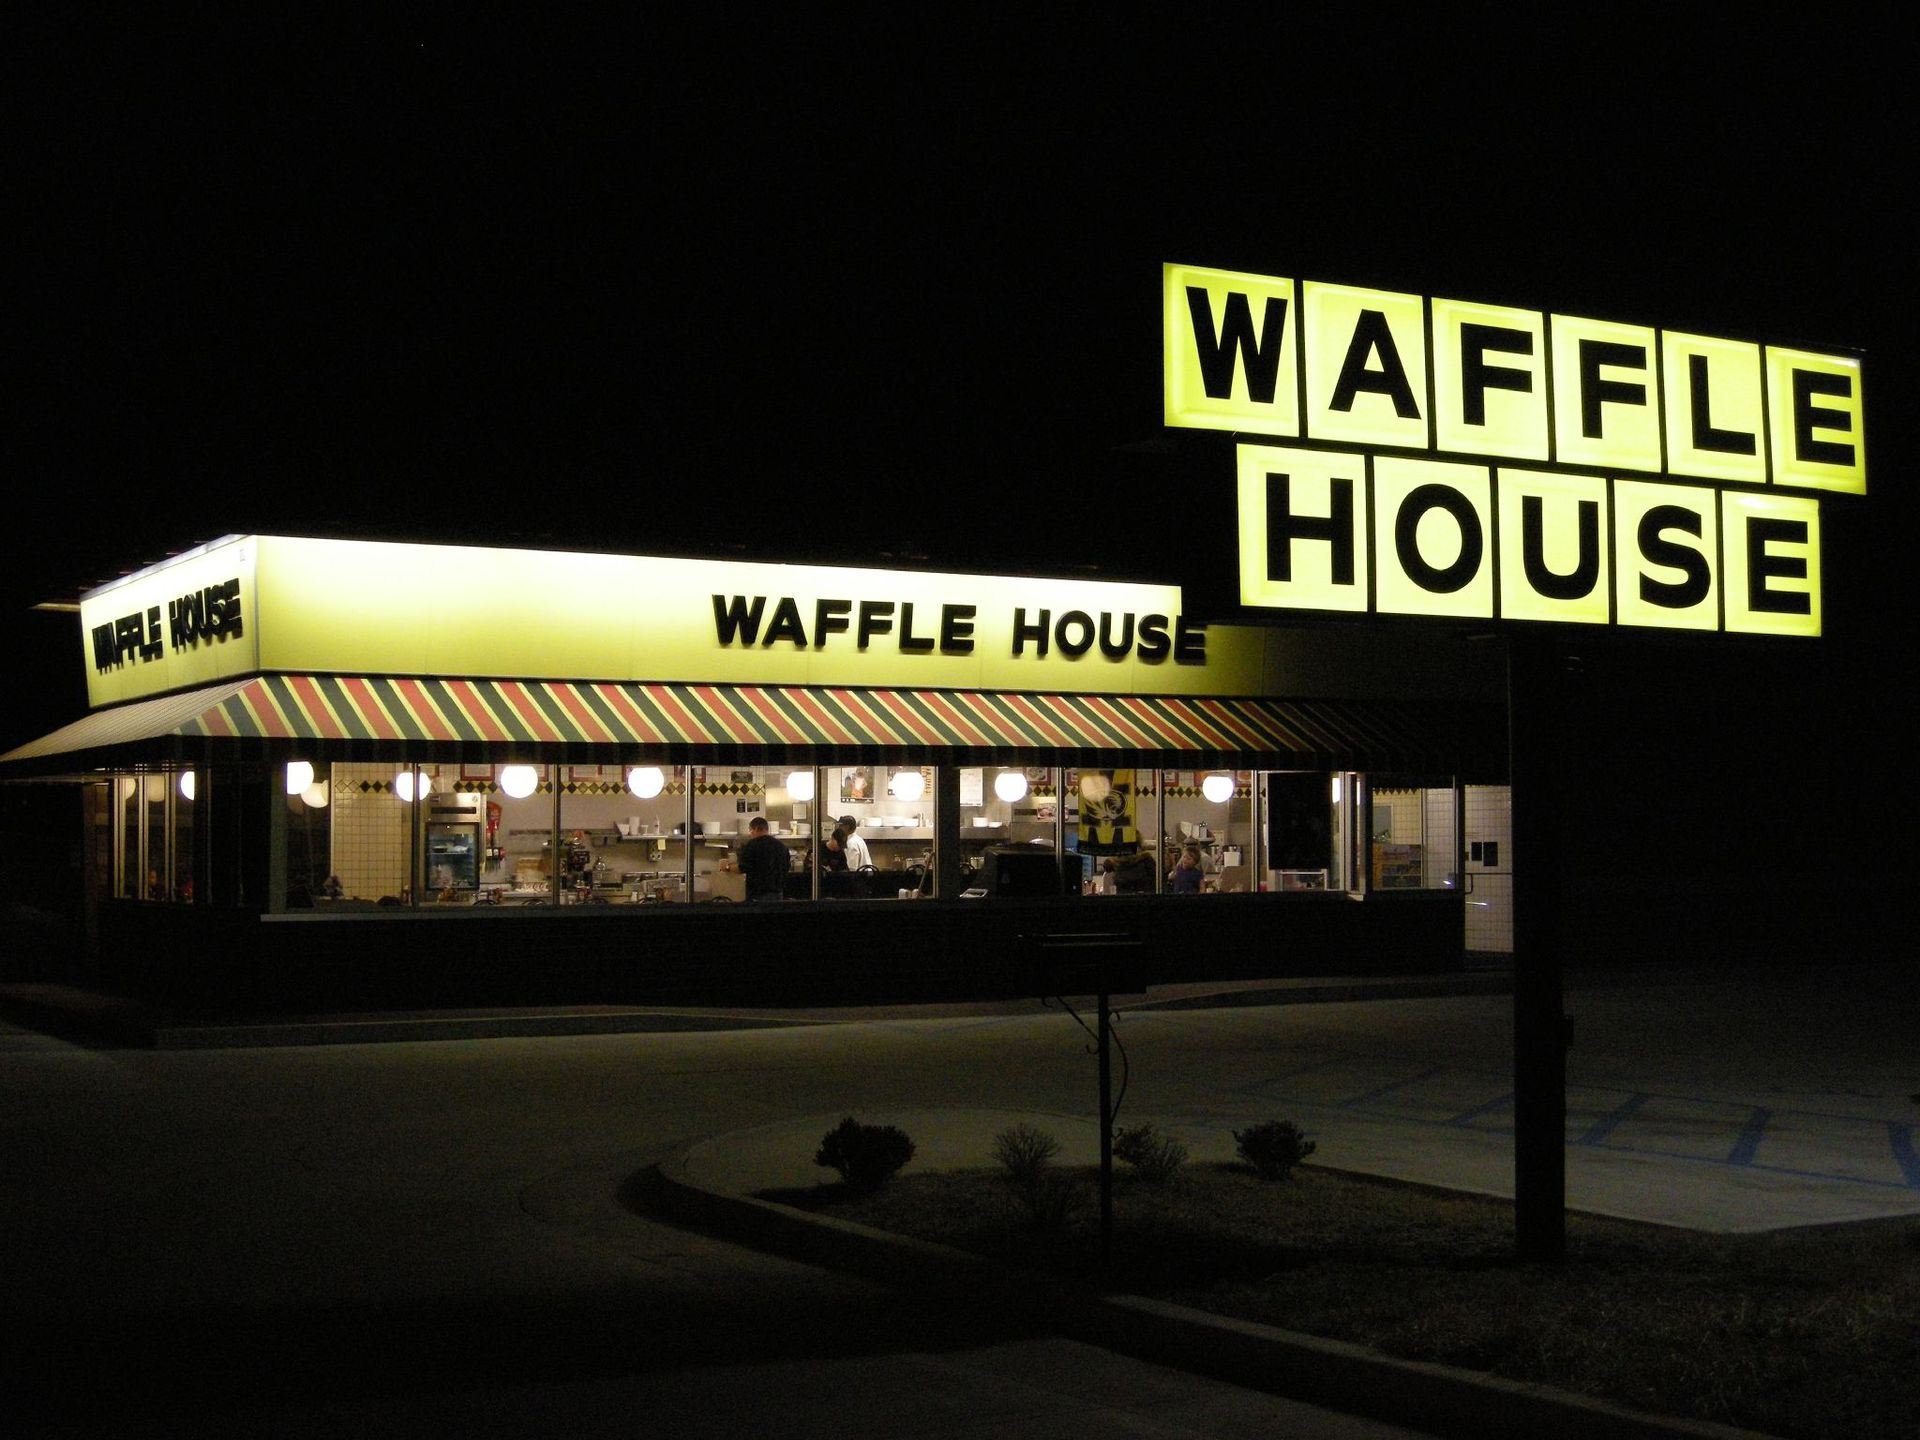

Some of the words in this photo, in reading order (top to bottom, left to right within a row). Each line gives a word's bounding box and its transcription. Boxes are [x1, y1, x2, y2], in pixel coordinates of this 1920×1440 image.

[1186, 286, 1856, 467] WAFFLE
[1265, 472, 1811, 615] HOUSE
[91, 605, 163, 671] WAFFLE
[168, 578, 243, 649] HOUSE
[712, 594, 977, 654] WAFFLE
[1013, 607, 1207, 665] HOUSE
